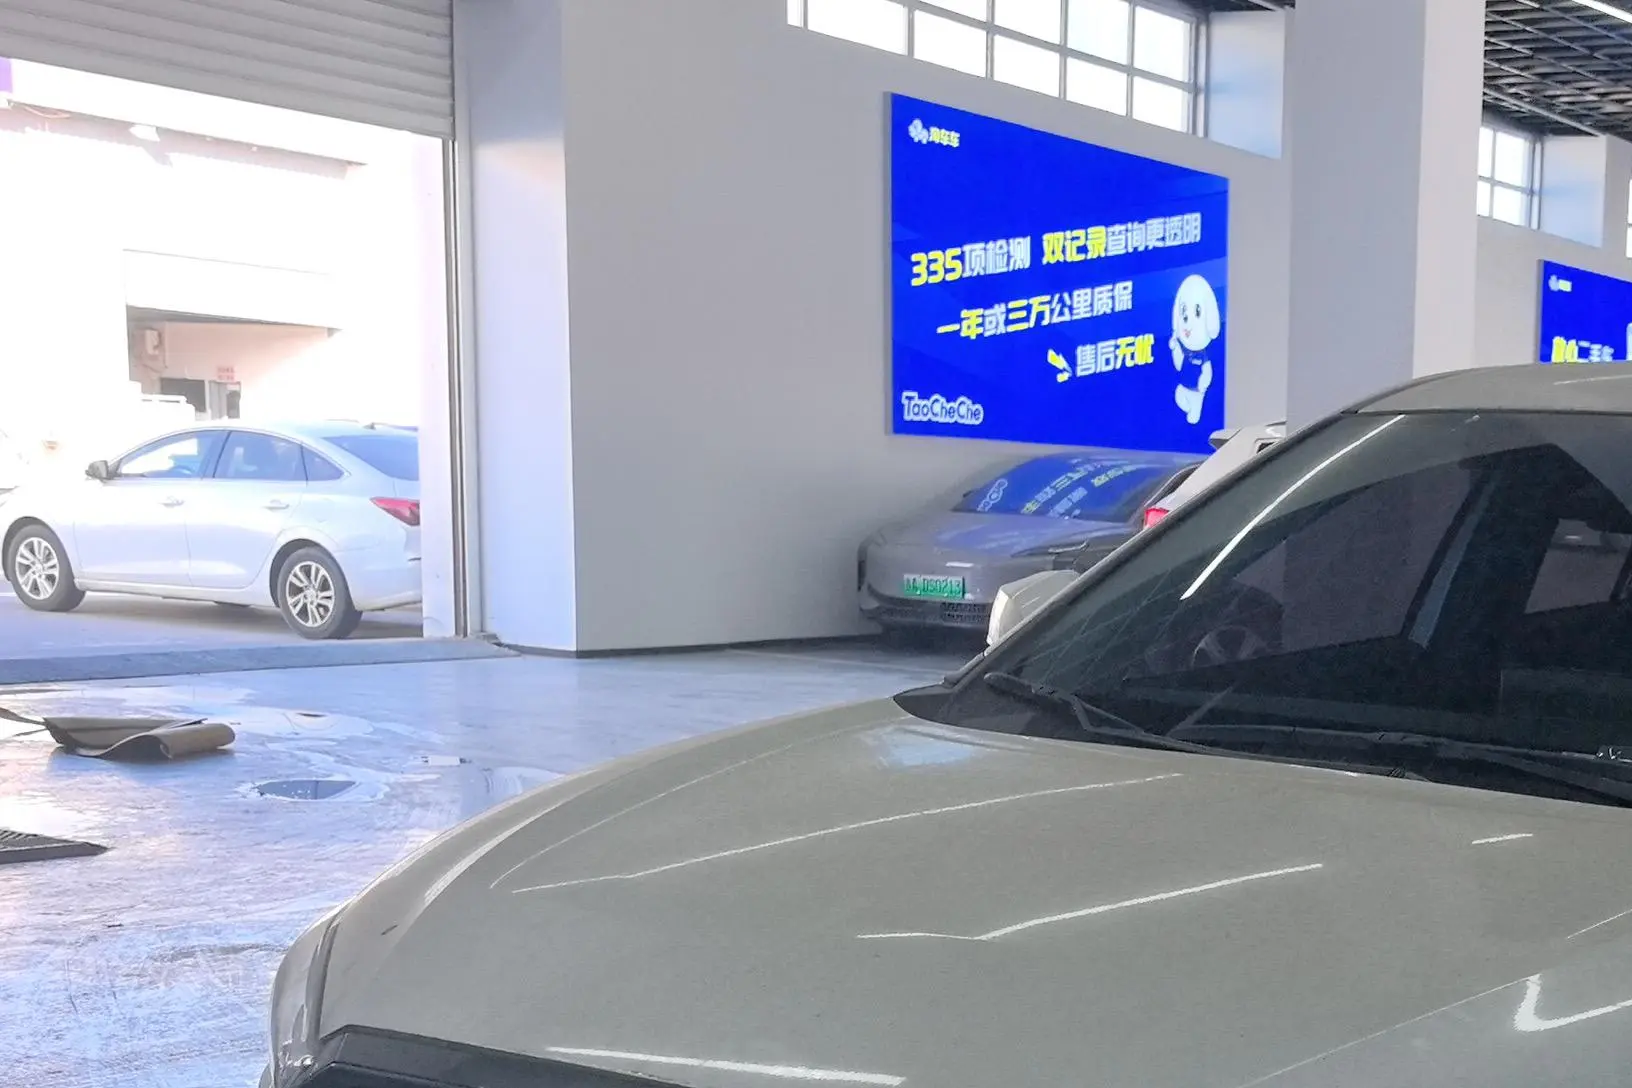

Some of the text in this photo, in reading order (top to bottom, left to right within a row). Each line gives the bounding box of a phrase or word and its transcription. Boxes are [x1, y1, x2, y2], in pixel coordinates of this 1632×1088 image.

[911, 212, 1201, 286] 335项检测 双记录查询更透明
[937, 281, 1133, 340] 一年或三万公里质保
[1076, 333, 1154, 377] 售后无忧
[903, 392, 983, 424] TaoCheChe
